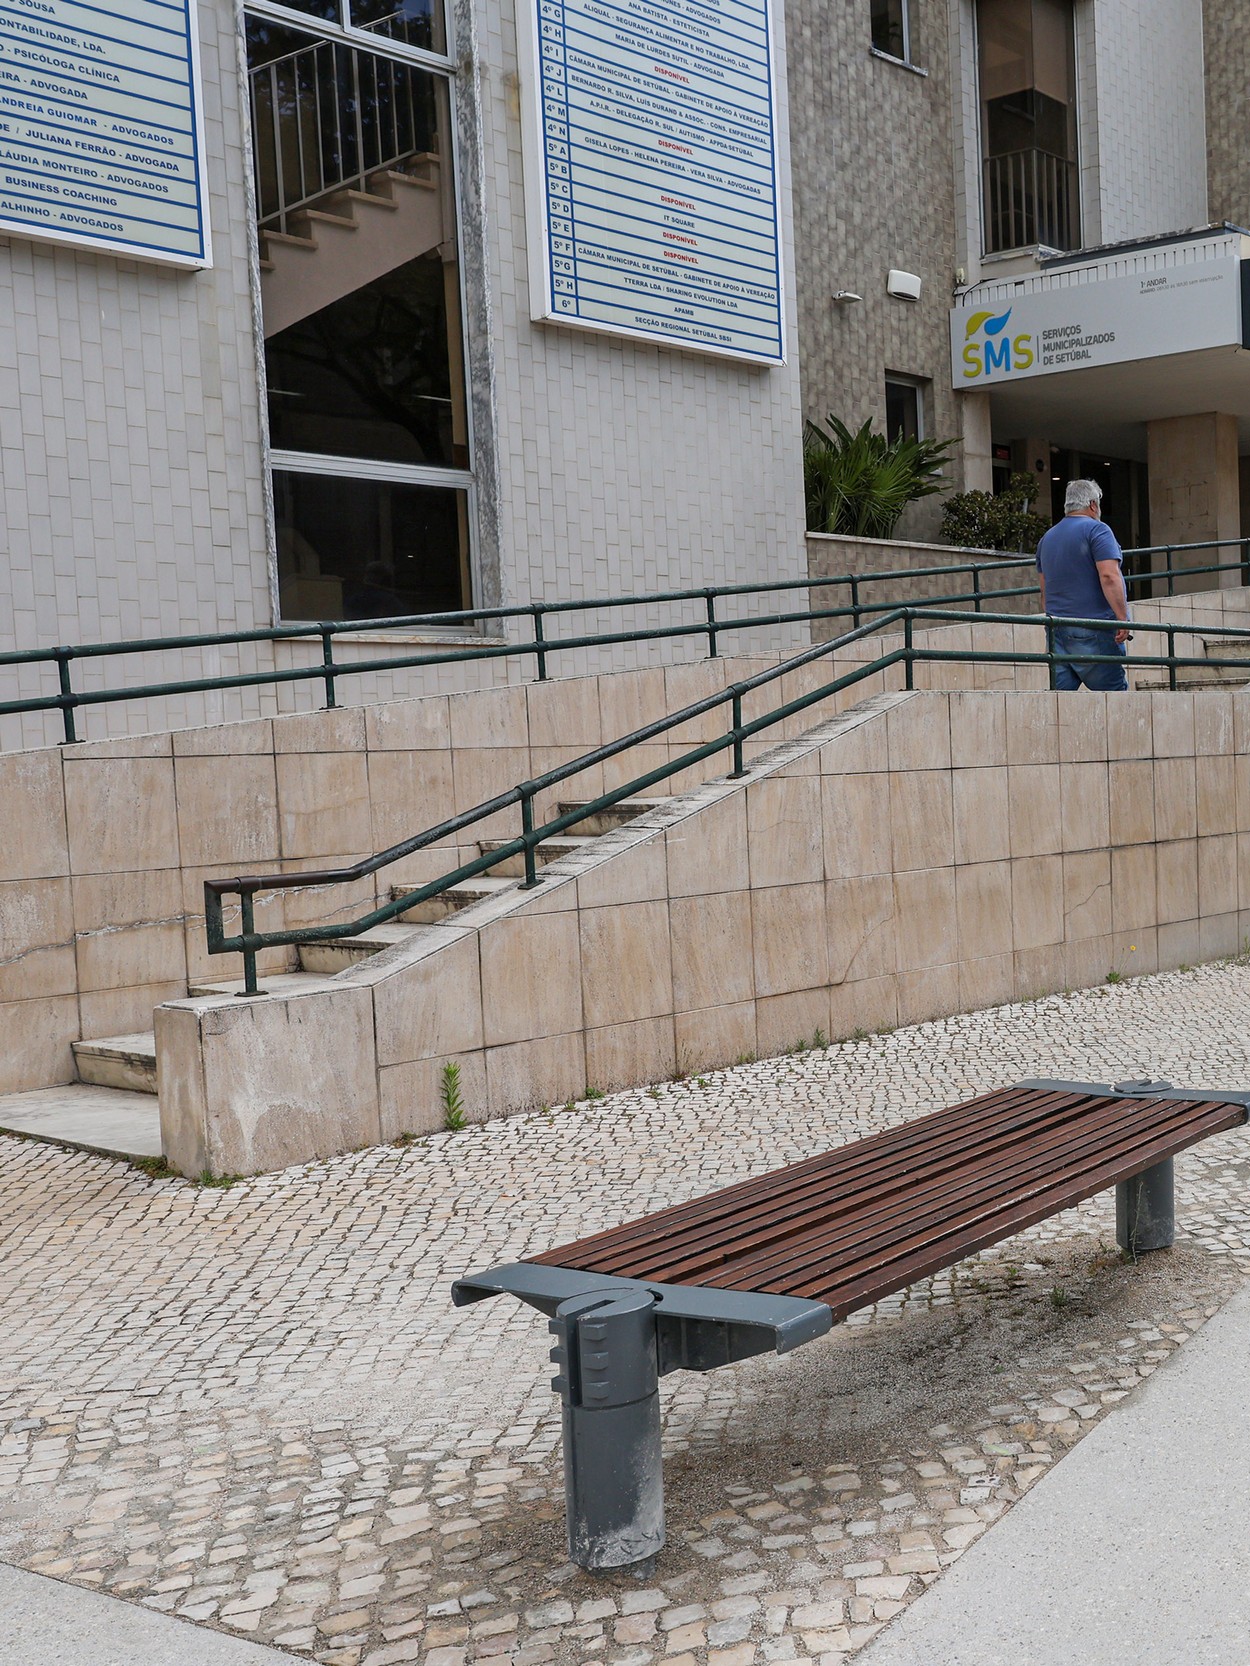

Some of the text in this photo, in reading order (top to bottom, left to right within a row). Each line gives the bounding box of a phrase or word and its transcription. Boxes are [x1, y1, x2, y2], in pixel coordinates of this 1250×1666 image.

[554, 10, 560, 18] G
[628, 2, 710, 37] ANA BATISTA ESTETICISTA
[686, 6, 720, 24] ADVOGADOS
[554, 29, 561, 38] H
[584, 4, 610, 19] ALIQUAL
[616, 16, 654, 34] SEGURANÇA
[655, 31, 688, 48] ALIMENTAR
[696, 45, 704, 54] NO
[706, 50, 738, 66] TRABALHO,
[83, 41, 106, 54] LDA.
[615, 33, 724, 78] MARIA DE LURDES SUTIL ADVOGADA
[14, 47, 121, 83] PSICÓLOGA CLÍNICA
[654, 66, 690, 84] DISPONÍVEL
[30, 79, 88, 100] ADVOGADA
[558, 88, 562, 96] L
[568, 54, 596, 69] CÂMARA
[597, 64, 632, 81] MUNICIPAL
[632, 76, 641, 84] DE
[642, 80, 670, 94] SETÚBAL
[674, 91, 704, 106] GABINETE
[714, 104, 732, 116] APOIO
[738, 113, 768, 128] VEREAÇÃO
[558, 107, 566, 117] M
[572, 75, 606, 92] BERNARDO
[652, 102, 678, 116] DURAND
[685, 114, 706, 125] ASSOC.
[710, 122, 728, 133] CONS.
[729, 128, 768, 145] EMPRESARIAL
[0, 96, 174, 145] NDREIA GUIOMAR ADVOGADOS
[616, 108, 654, 126] DELEGAÇÃO
[662, 123, 674, 132] SUL
[678, 128, 705, 142] AUTISMO
[559, 127, 566, 136] N
[25, 129, 179, 172] JULIANA FERRÃO ADVOGADA
[560, 146, 566, 156] A
[658, 139, 694, 156] DISPONÍVEL
[561, 166, 568, 174] B
[584, 136, 760, 194] GISELA LOPES HELENA PEREIRA VERA SILVA ADVOGADAS
[42, 159, 98, 178] MONTEIRO
[107, 174, 169, 193] ADVOGADOS
[5, 176, 118, 206] BUSINESS COACHING
[562, 185, 568, 194] C
[563, 205, 570, 213] D
[660, 195, 696, 210] DISPONÍVEL
[59, 212, 124, 232] ADVOGADOS
[564, 224, 570, 232] E
[664, 214, 695, 228] IT SQUARE
[662, 231, 698, 246] DISPONÍVEL
[566, 244, 571, 252] F
[664, 250, 698, 264] DISPONÍVEL
[564, 262, 571, 270] G
[578, 248, 606, 260] CÂMARA
[606, 255, 640, 268] MUNICIPAL
[652, 265, 679, 278] SETÚBAL
[684, 273, 712, 286] GABINETE
[714, 280, 722, 288] DE
[722, 282, 740, 292] APOIO
[746, 288, 775, 300] VEREAÇÃO
[566, 282, 573, 290] H
[1146, 277, 1168, 288] ANDAR
[624, 277, 648, 288] TTERRA
[650, 282, 662, 291] LDA
[666, 286, 692, 298] SHARING
[694, 293, 726, 306] EVOLUTION
[674, 307, 694, 316] APAMB
[635, 316, 732, 342] SECÇÃO REGIONAL SETÚBAL SBSI
[1042, 324, 1082, 340] SERVIÇOS
[1042, 332, 1116, 352] MUNICIPALIZADOS
[962, 334, 1034, 378] SMS
[1043, 349, 1092, 366] DE SETÚBAL
